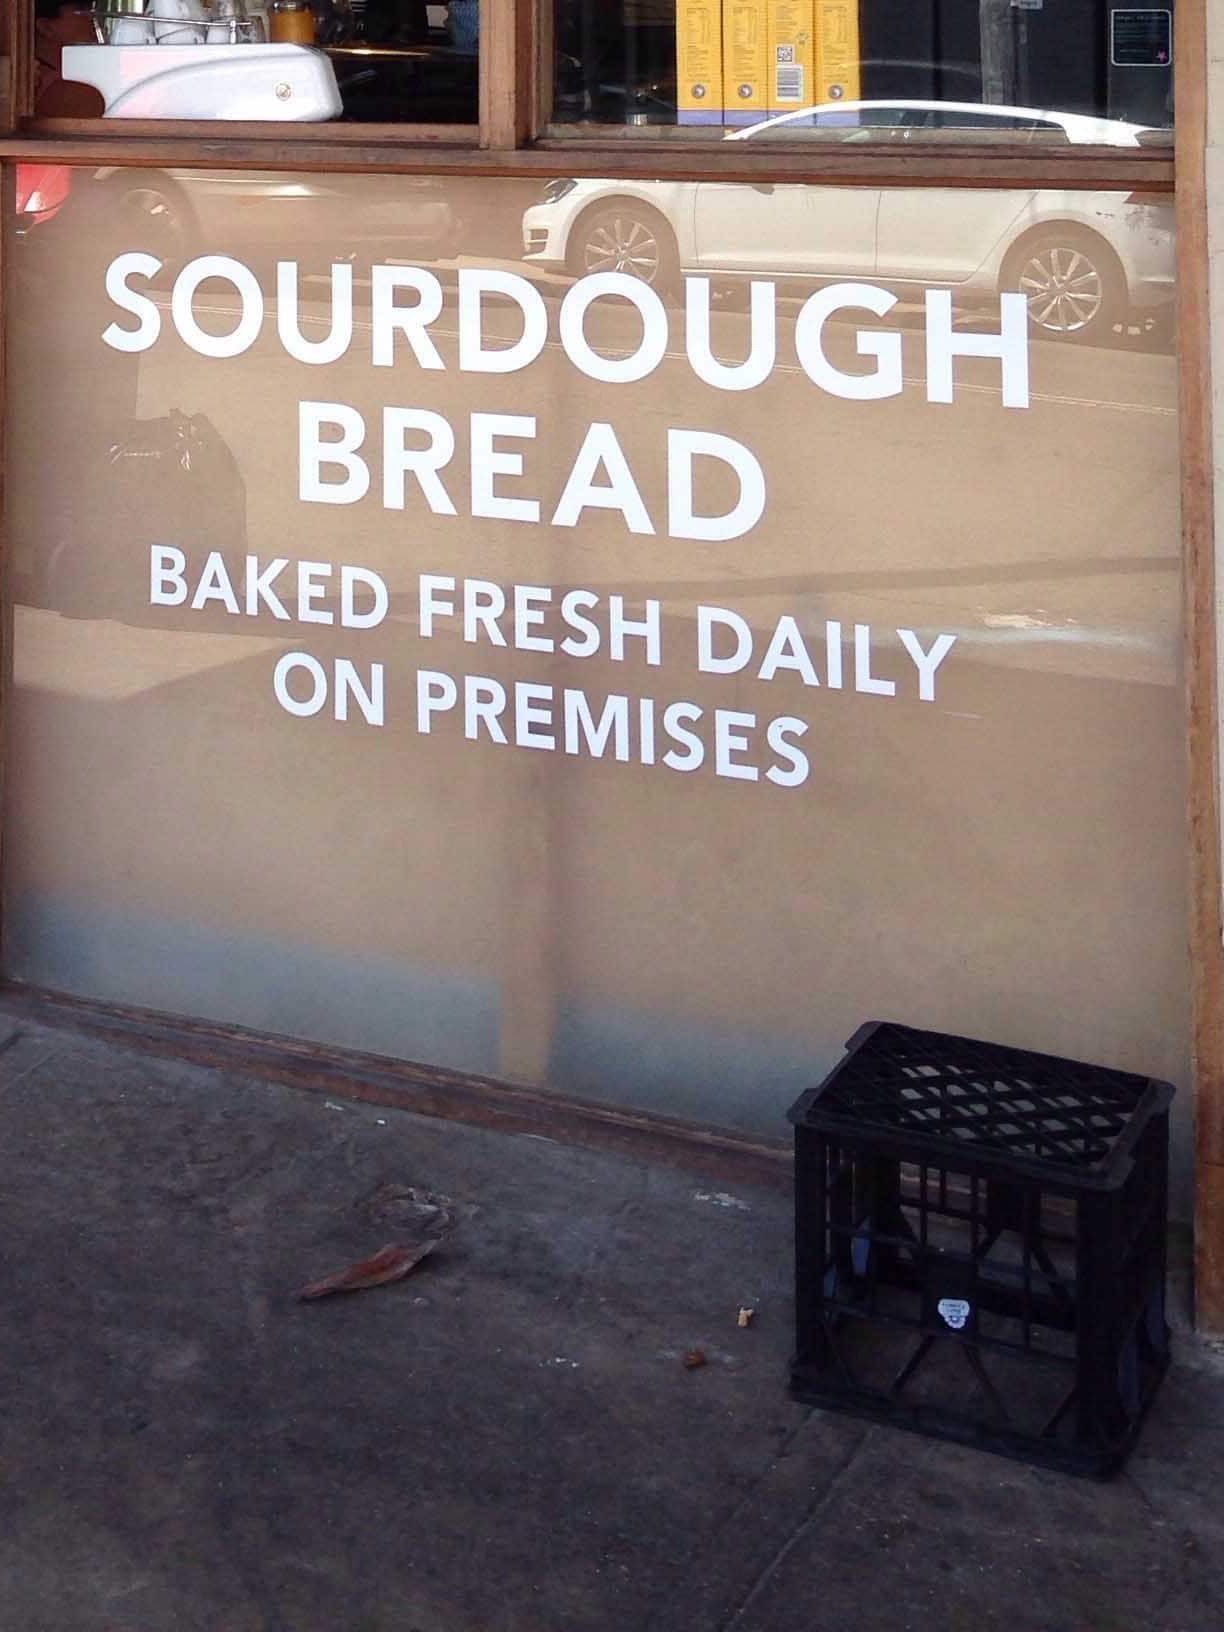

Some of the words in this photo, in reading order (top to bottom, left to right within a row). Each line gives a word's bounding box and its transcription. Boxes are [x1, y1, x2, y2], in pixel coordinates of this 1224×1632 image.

[101, 250, 1031, 410] SOURDOUGH
[298, 401, 768, 542] BREAD
[149, 545, 390, 631] BAKED
[418, 574, 661, 667] FRESH
[697, 605, 958, 703] DAILY
[272, 651, 385, 728] ON
[416, 668, 812, 790] PREMISES
